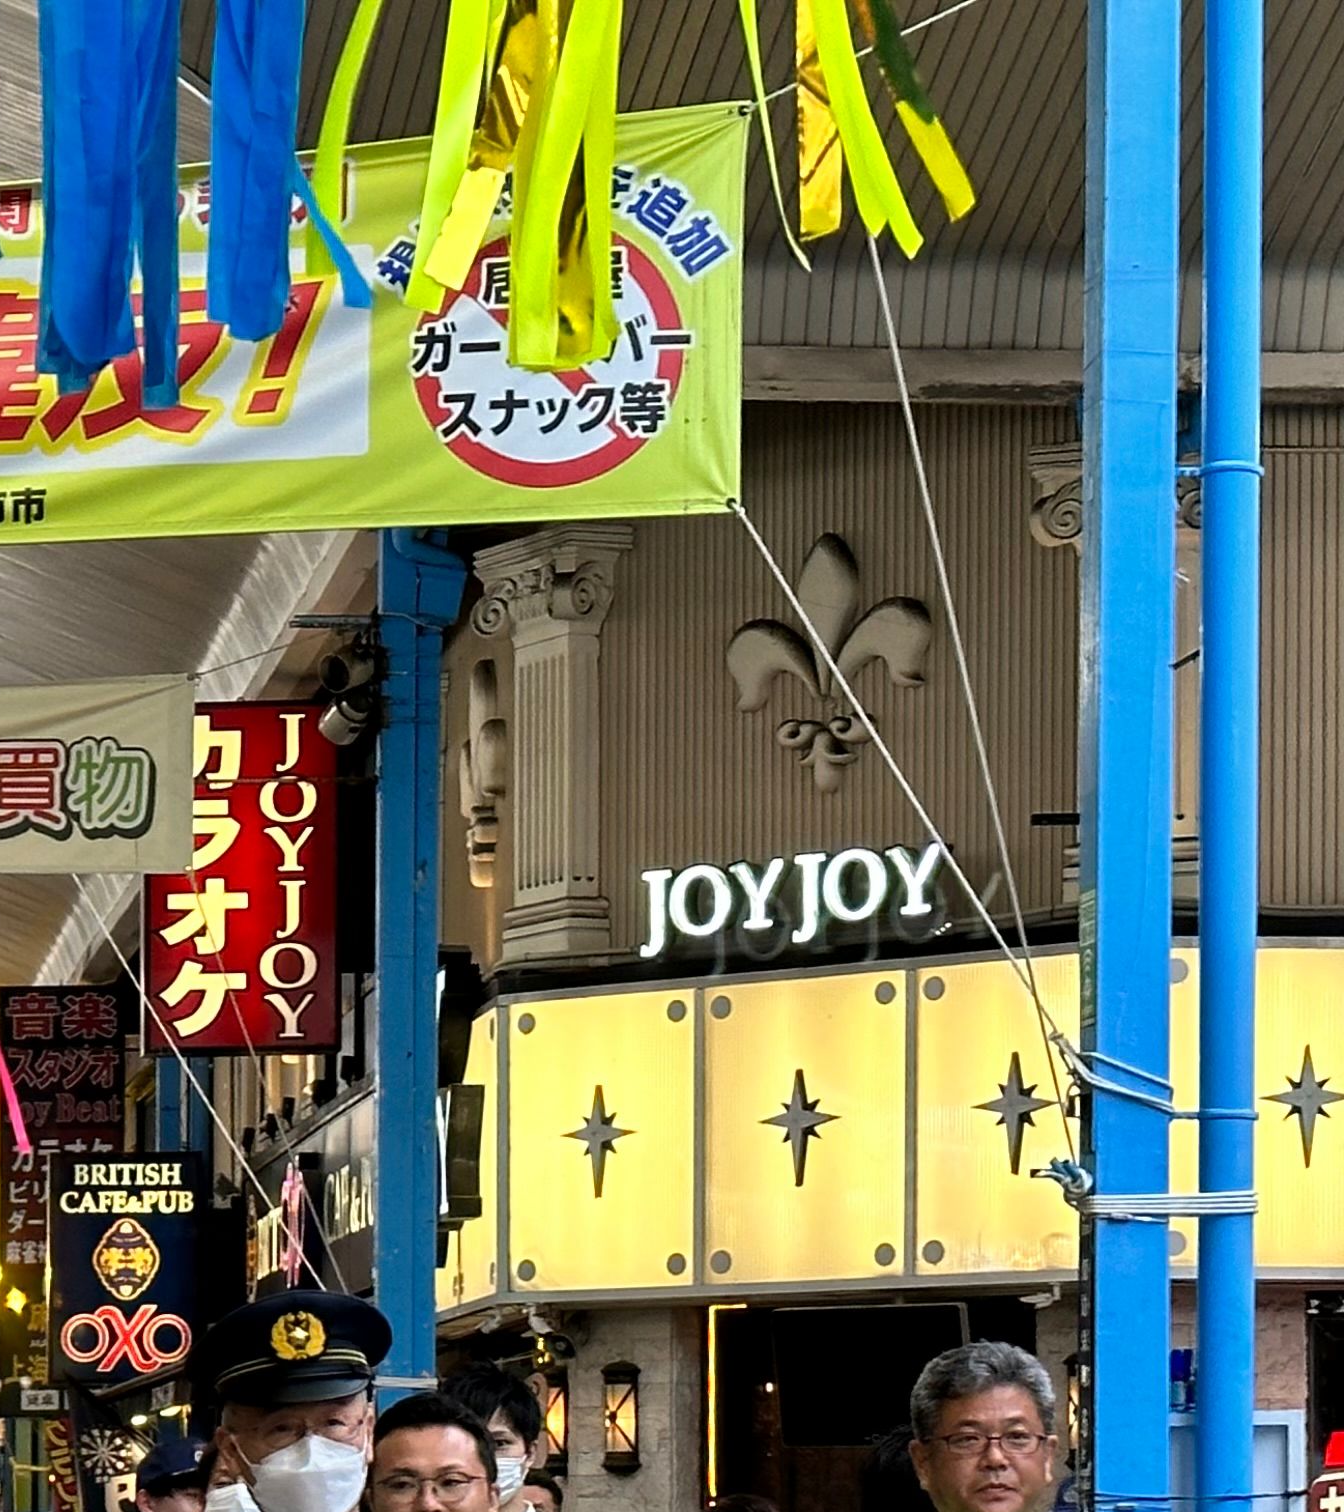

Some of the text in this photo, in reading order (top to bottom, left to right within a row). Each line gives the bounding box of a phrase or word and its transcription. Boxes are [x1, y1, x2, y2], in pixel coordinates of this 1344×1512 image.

[440, 382, 666, 438] スナック等
[160, 714, 249, 1038] カラオケ
[258, 712, 318, 1039] JOYJOY
[640, 841, 942, 958] JOYJOY
[5, 992, 118, 1040] 音楽
[8, 1045, 120, 1090] スタジオ
[55, 1092, 123, 1123] Beat
[73, 1162, 182, 1186] BRITISH
[60, 1303, 192, 1373] OXO
